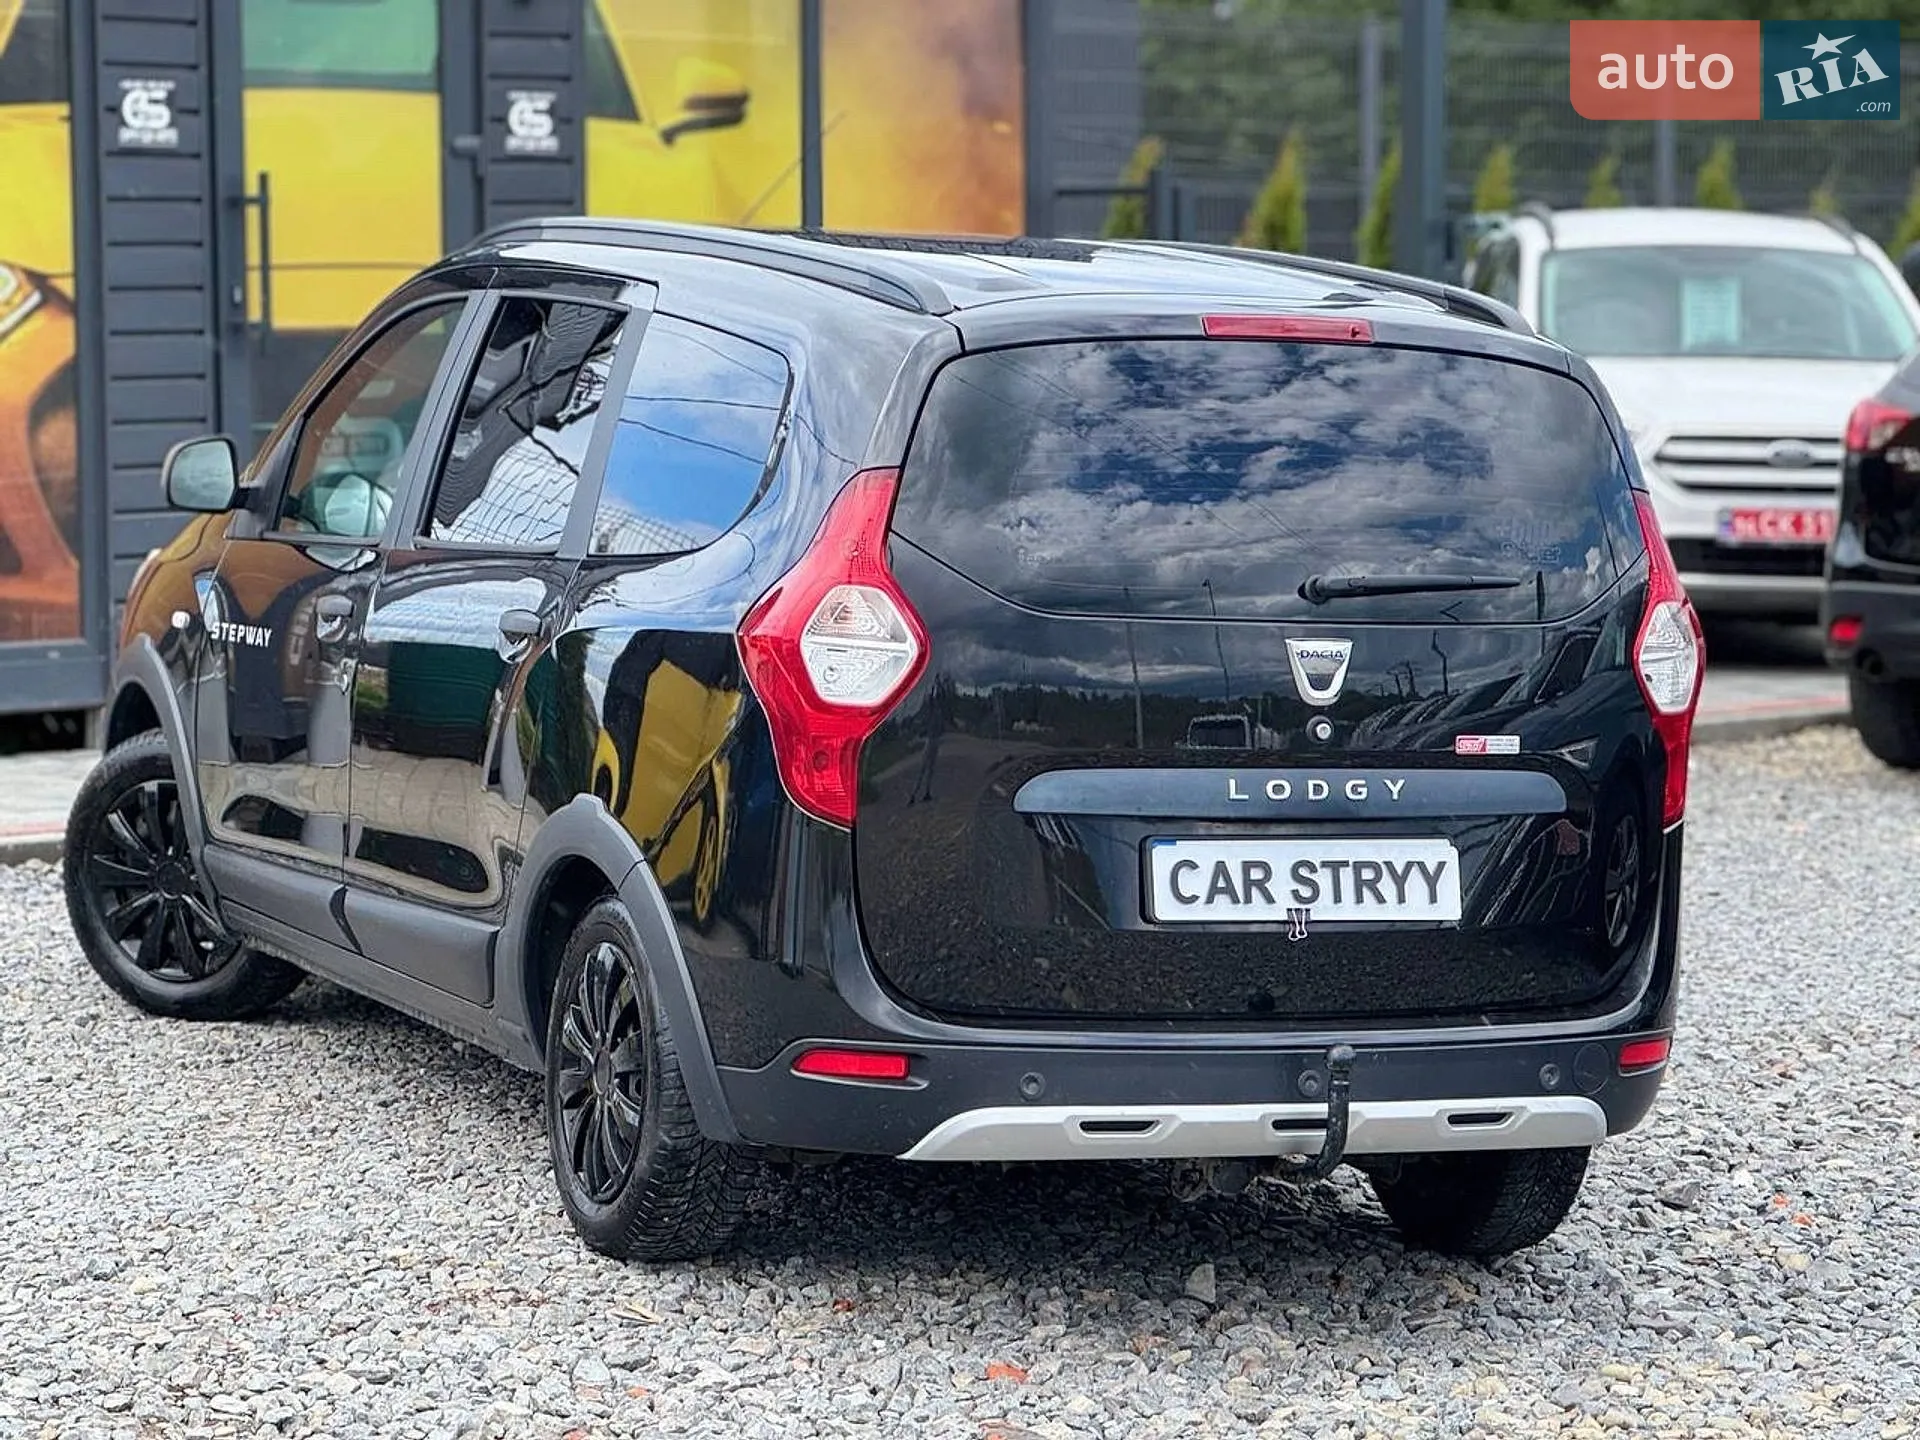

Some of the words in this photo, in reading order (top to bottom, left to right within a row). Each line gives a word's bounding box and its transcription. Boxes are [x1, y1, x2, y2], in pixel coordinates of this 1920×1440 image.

[210, 621, 273, 648] STEPWAY
[1300, 649, 1344, 659] DACIA
[1227, 778, 1406, 801] LODGY
[1169, 859, 1276, 906] CAR
[1290, 859, 1448, 907] STRYY
